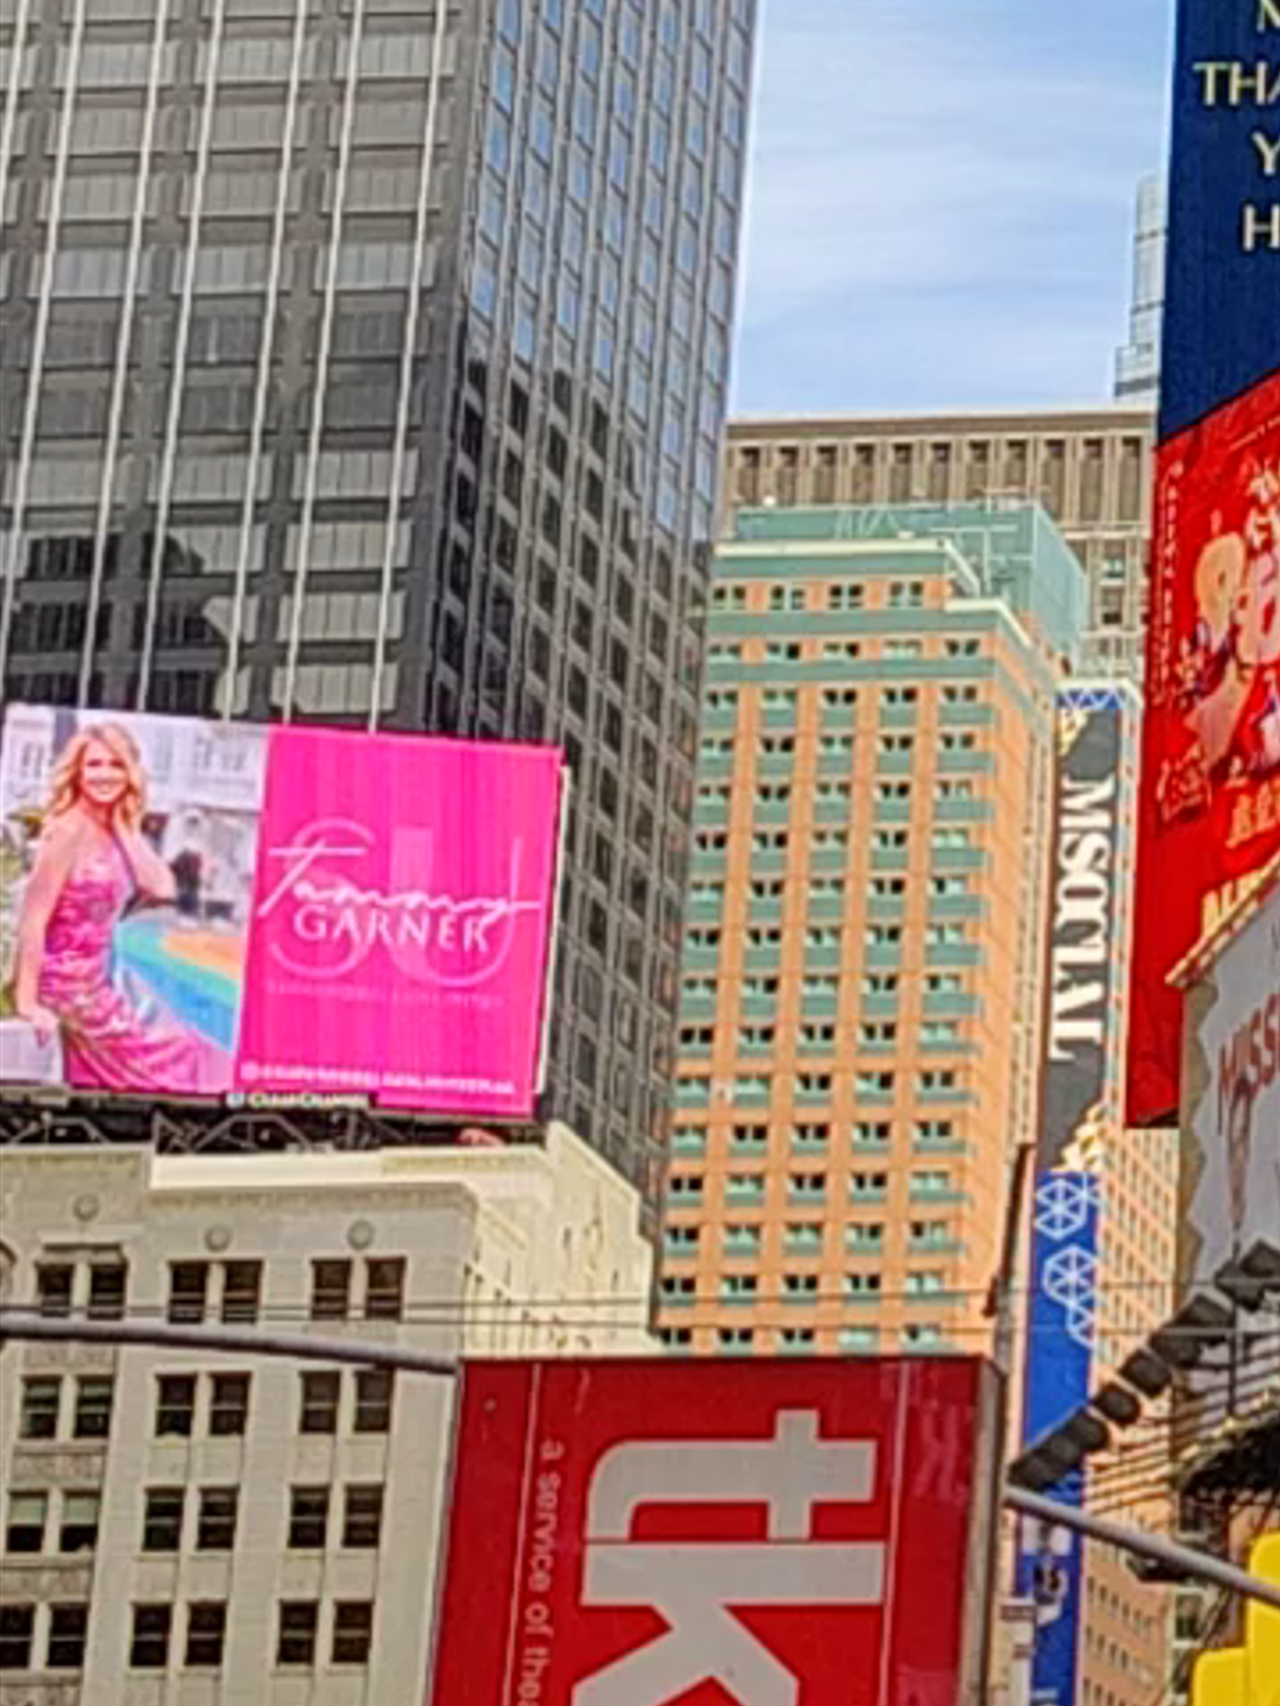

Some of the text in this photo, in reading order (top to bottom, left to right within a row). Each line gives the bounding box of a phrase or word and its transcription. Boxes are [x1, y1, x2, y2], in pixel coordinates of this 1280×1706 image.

[293, 903, 490, 953] GARNER
[541, 1441, 565, 1461] a
[528, 1472, 564, 1592] service
[524, 1602, 554, 1638] of
